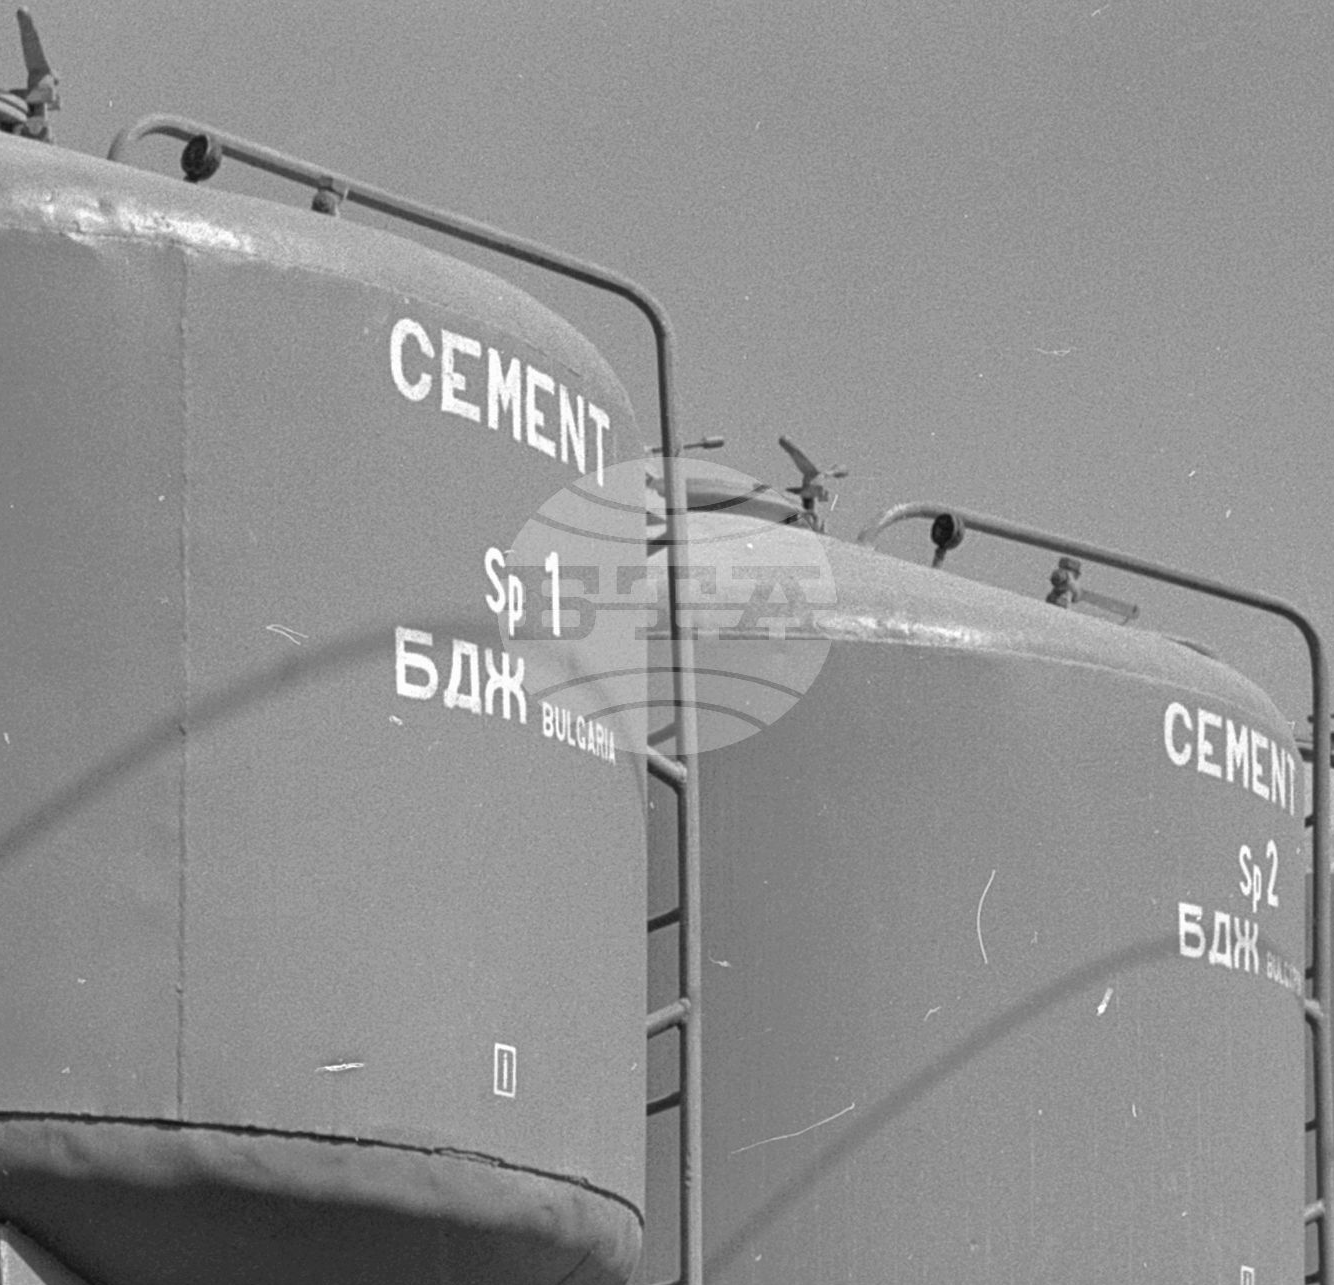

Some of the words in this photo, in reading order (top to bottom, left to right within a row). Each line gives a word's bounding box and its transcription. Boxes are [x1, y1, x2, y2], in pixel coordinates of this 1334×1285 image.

[390, 317, 610, 487] CEMENT
[484, 546, 523, 637] Sp
[544, 550, 561, 637] 1
[394, 626, 527, 725] БДЖ
[542, 701, 616, 765] BULGARIA
[1164, 701, 1295, 817] CEMENT
[1265, 838, 1279, 908] 2
[1178, 901, 1259, 975] БДЖ
